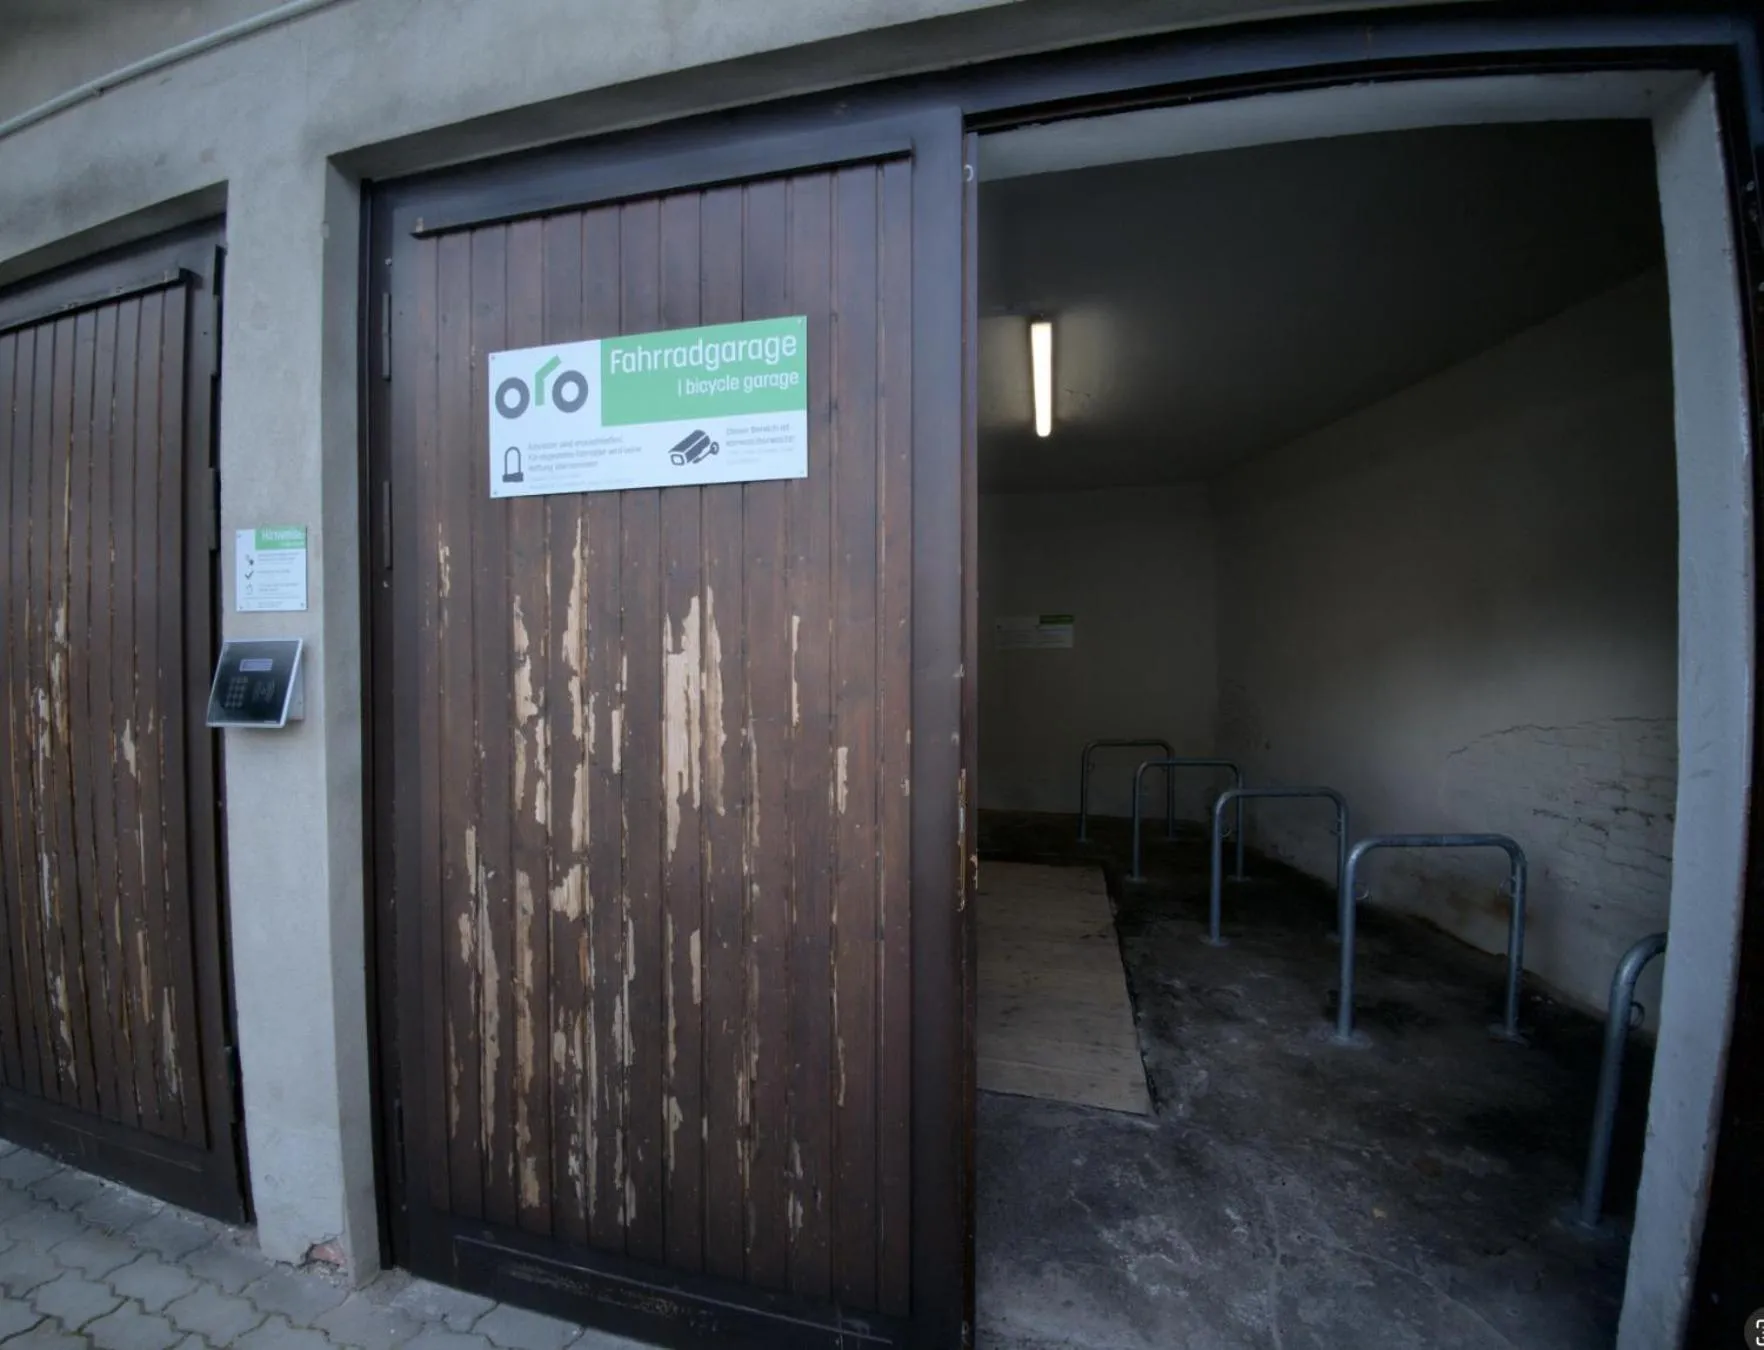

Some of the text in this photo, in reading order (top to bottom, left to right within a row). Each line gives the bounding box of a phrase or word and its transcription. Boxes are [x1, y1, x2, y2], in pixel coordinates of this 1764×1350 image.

[610, 334, 798, 375] Fahrradgarage
[685, 374, 740, 396] bicycle
[743, 371, 800, 393] garage
